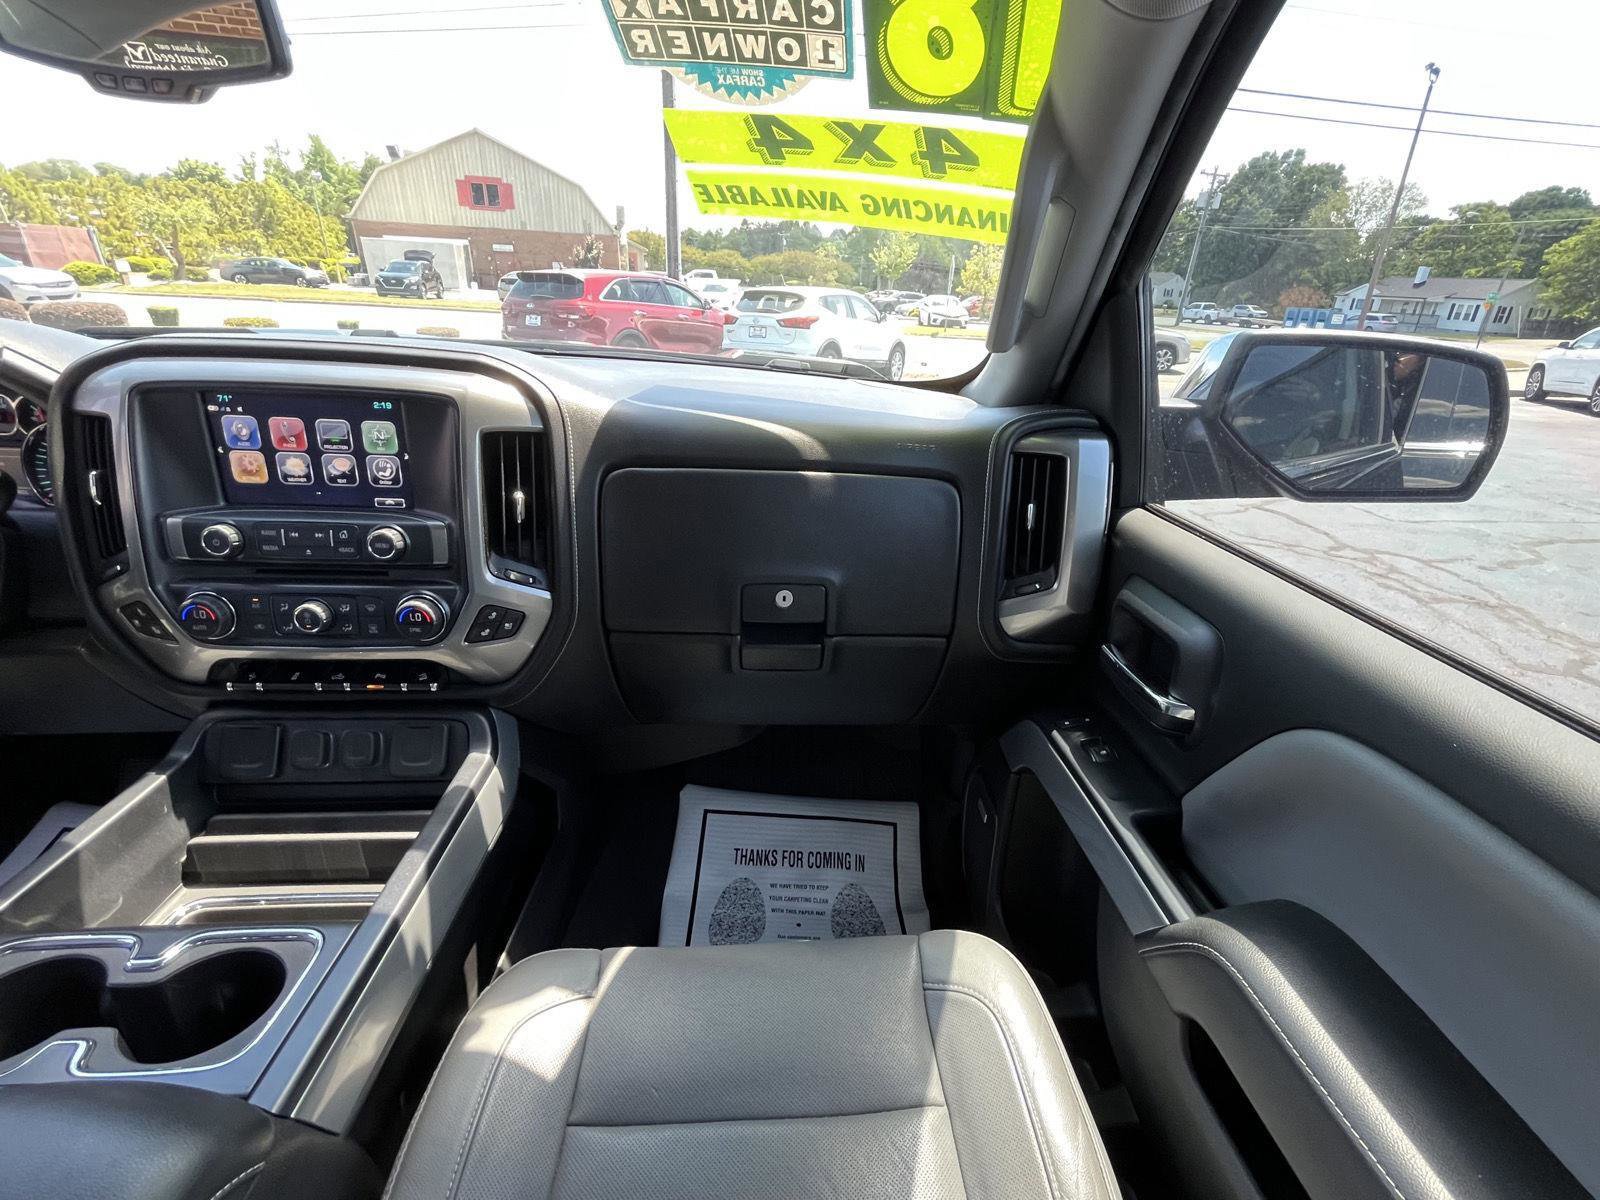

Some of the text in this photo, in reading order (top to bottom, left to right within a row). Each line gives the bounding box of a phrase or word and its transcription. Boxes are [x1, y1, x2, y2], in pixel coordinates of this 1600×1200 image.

[373, 401, 392, 410] 2:19
[733, 847, 865, 872] THANKS FOR COMING IN
